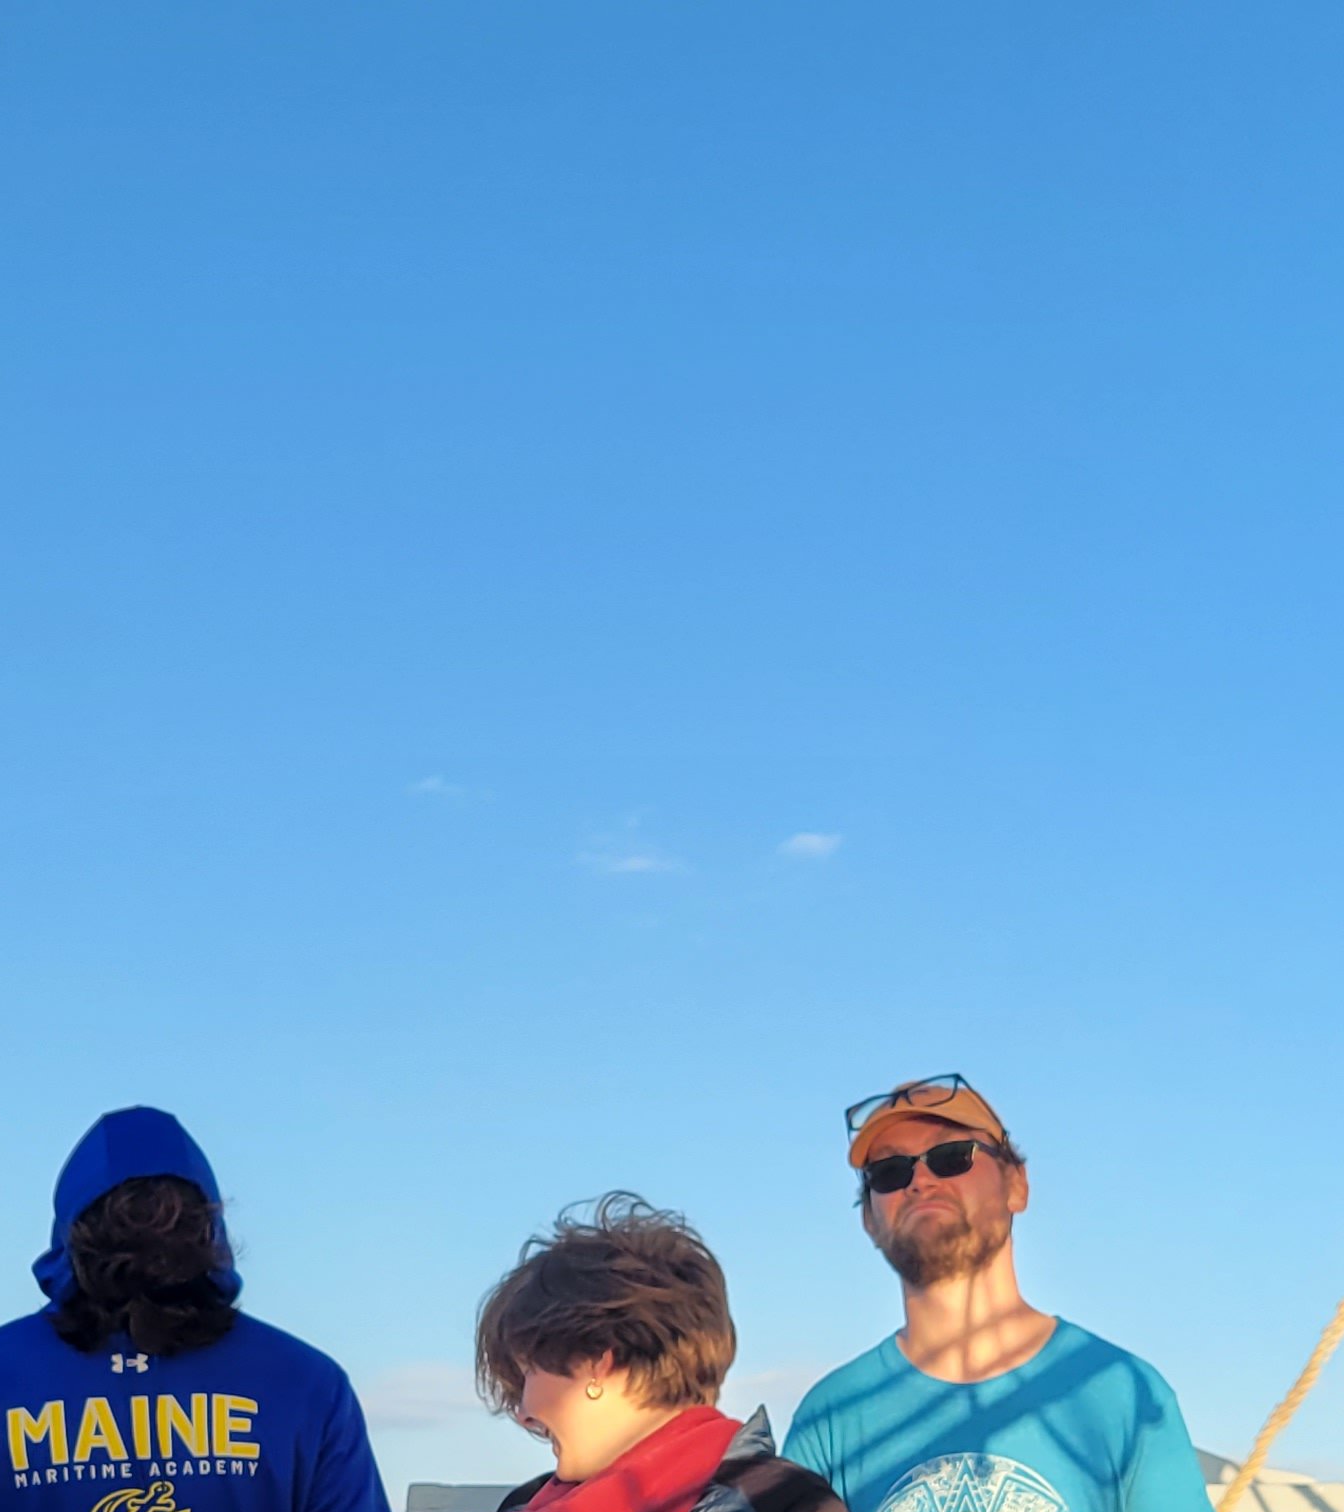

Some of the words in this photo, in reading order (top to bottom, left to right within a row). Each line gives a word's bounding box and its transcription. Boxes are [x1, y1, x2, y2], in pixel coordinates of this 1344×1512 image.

[7, 1392, 260, 1472] MAINE
[15, 1462, 133, 1489] MARITIME
[149, 1460, 259, 1477] ACADEMY
